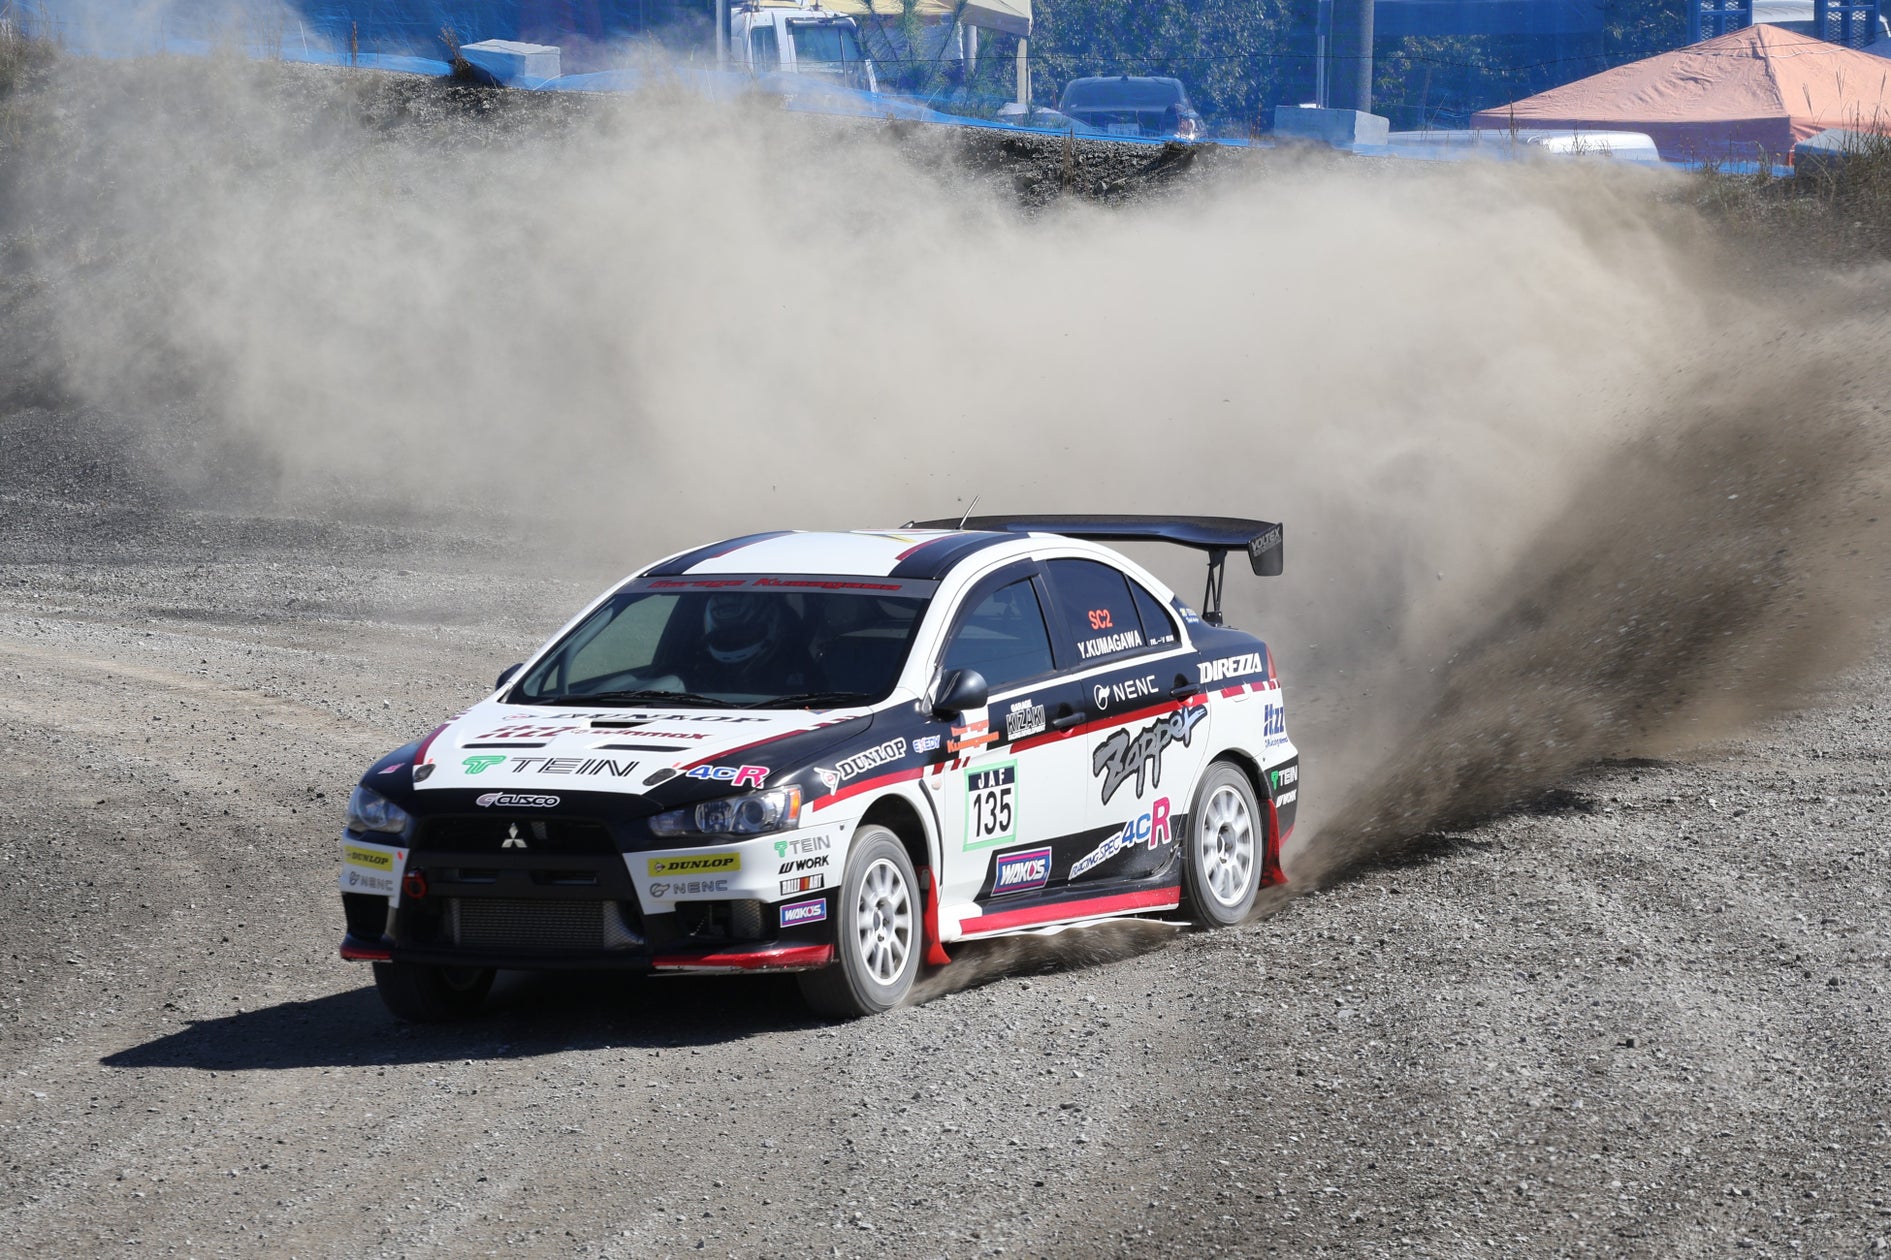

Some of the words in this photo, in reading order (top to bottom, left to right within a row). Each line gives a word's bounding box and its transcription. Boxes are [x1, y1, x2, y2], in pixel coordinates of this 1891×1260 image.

[1088, 609, 1113, 630] SC2
[1077, 630, 1142, 659] Y.KUMAGAWA
[1197, 653, 1262, 684] DIREZZA
[1113, 675, 1159, 702] NENC
[1006, 704, 1046, 735] KIZAKI
[912, 735, 941, 753] EXEDY
[510, 757, 640, 777] TEIN
[836, 738, 907, 780] DUNLOP
[973, 787, 1012, 838] 135
[789, 835, 832, 854] TEIN
[352, 852, 389, 866] DUNLOP
[667, 858, 734, 871] DUNLOP
[795, 855, 829, 871] WORK
[673, 880, 728, 894] NENC
